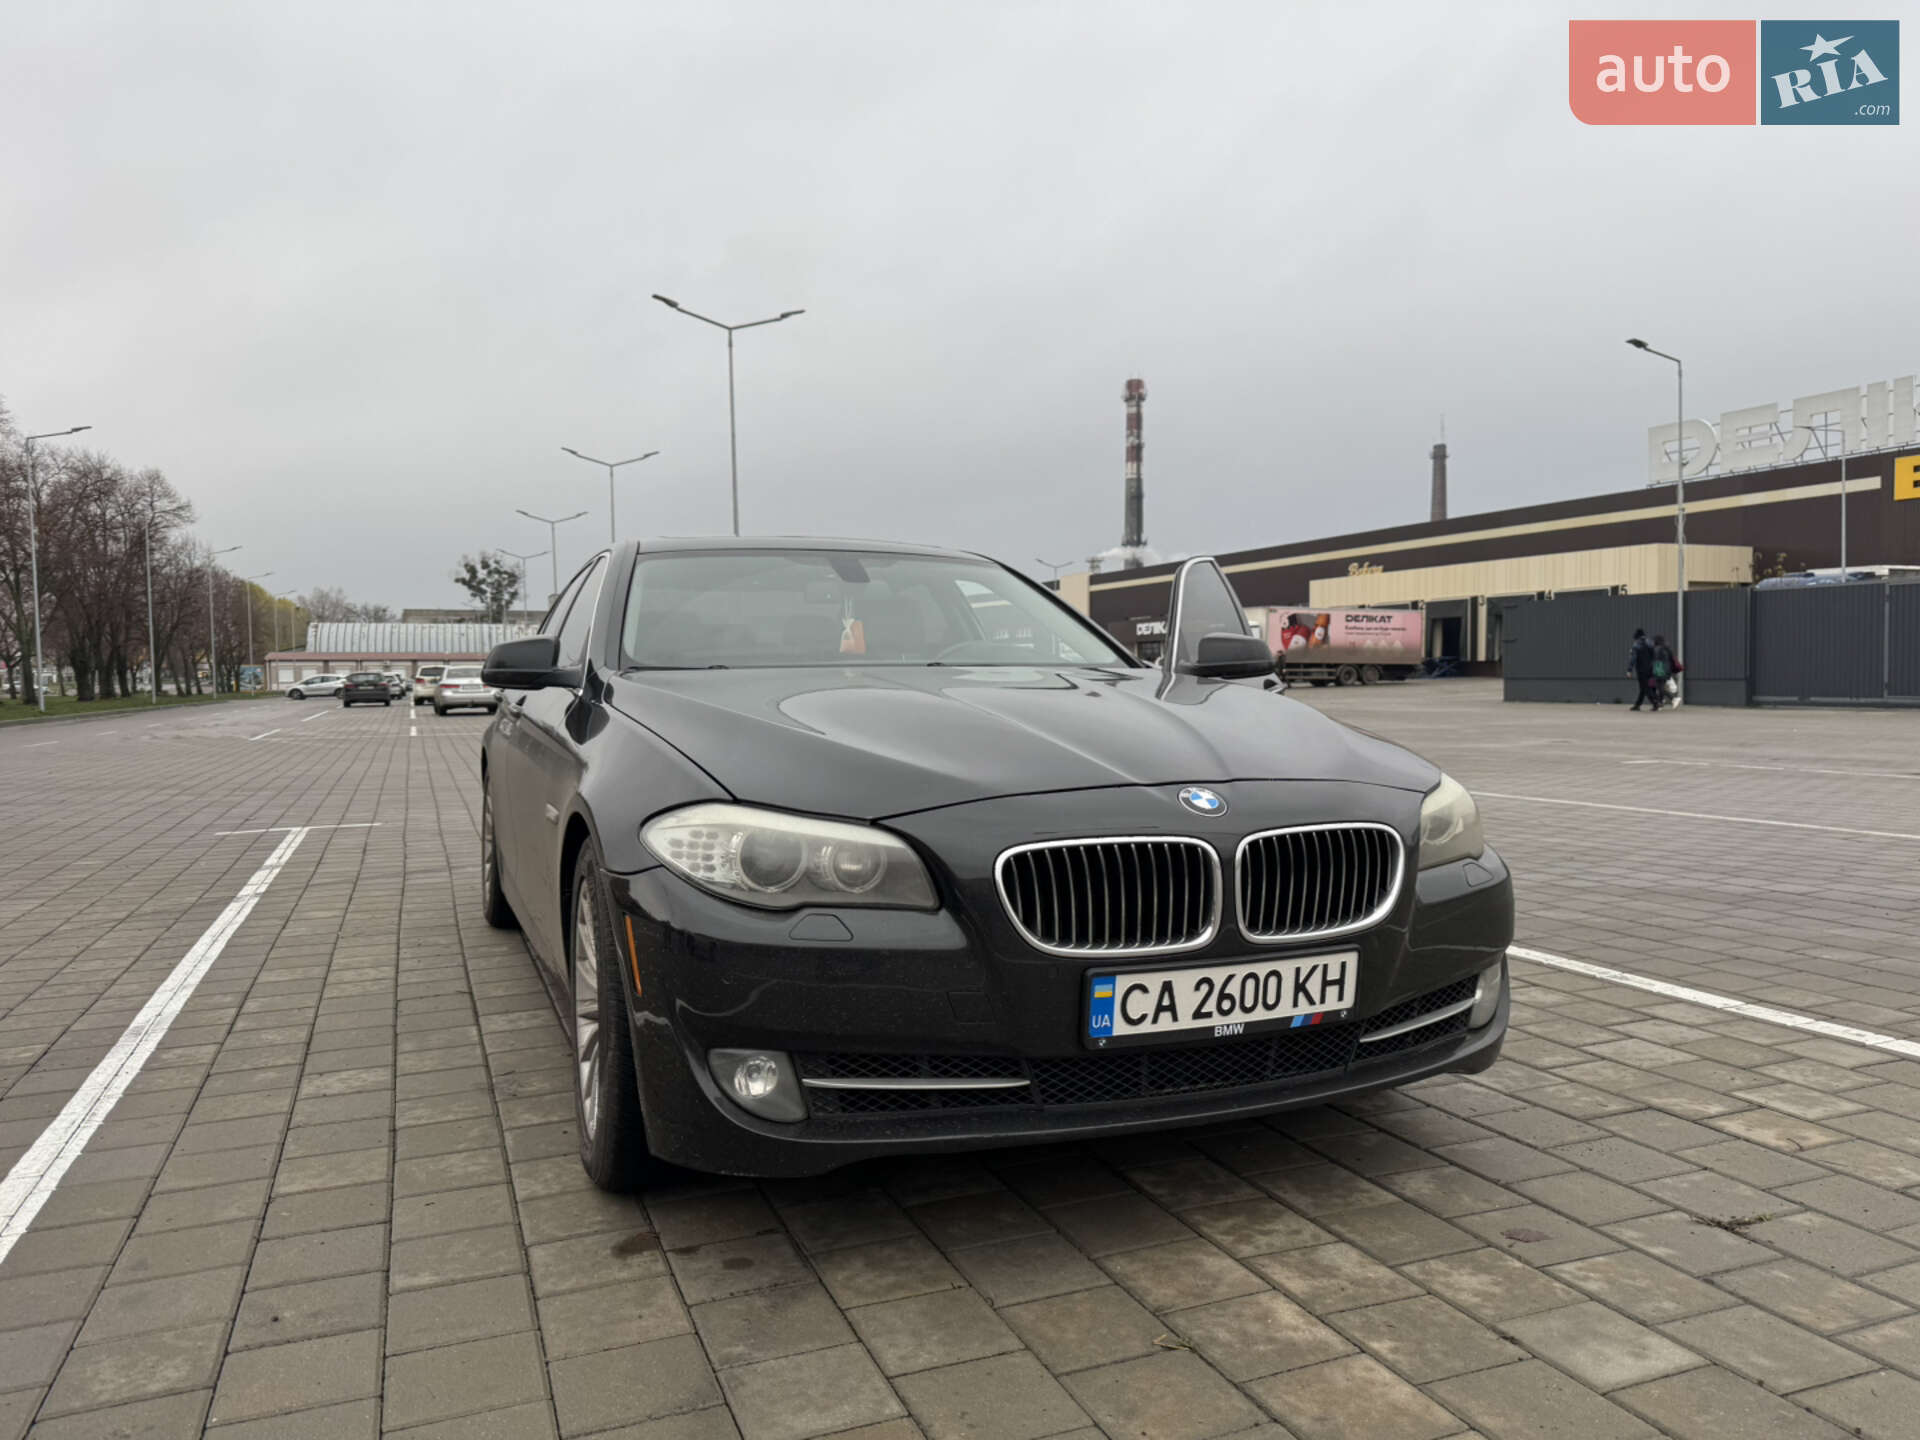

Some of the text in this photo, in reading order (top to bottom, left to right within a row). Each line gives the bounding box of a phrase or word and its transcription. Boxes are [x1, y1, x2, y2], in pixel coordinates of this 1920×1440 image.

[1120, 961, 1347, 1026] CA 2600 KH
[1092, 1014, 1111, 1029] UA
[1214, 1023, 1245, 1037] BMW
